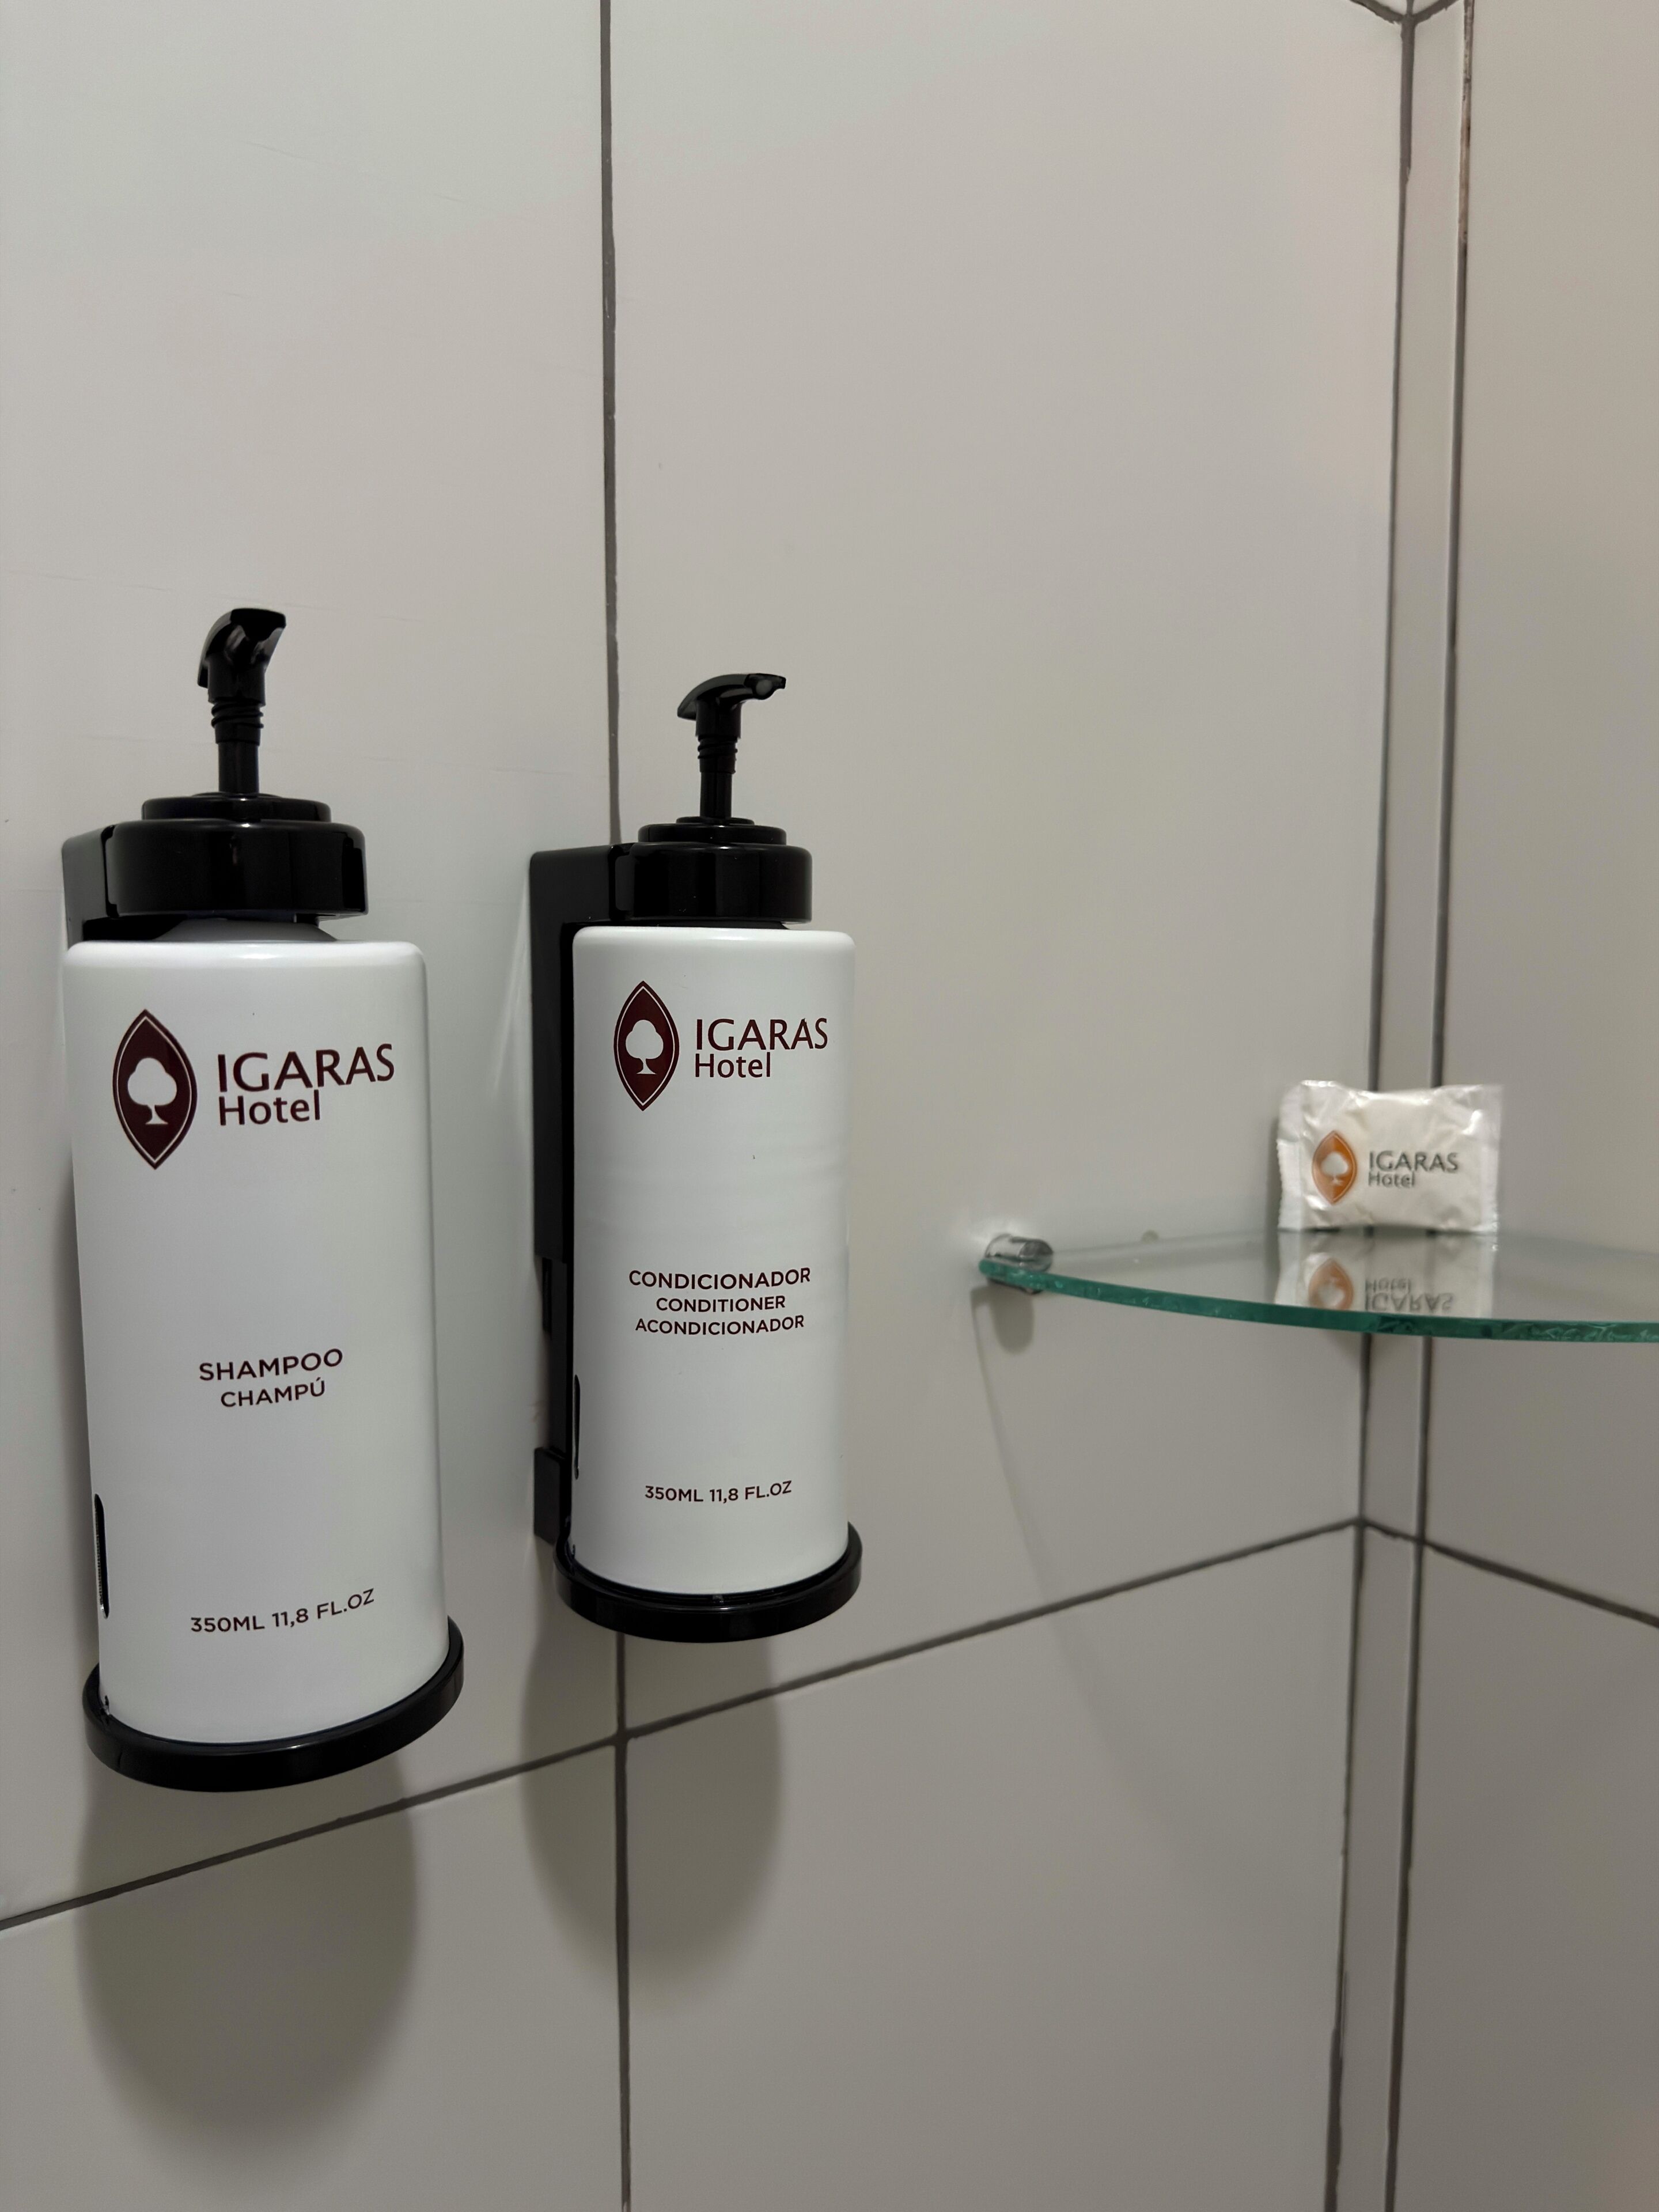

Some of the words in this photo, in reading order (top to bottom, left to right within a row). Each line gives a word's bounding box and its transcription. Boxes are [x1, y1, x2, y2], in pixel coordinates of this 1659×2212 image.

[696, 1017, 828, 1051] IGARAS
[217, 1043, 395, 1092] IGARAS
[695, 1052, 771, 1078] Hotel
[218, 1089, 321, 1126] Hotel
[1369, 1150, 1459, 1173] IGARAS
[1368, 1171, 1416, 1187] Hotel
[629, 1267, 810, 1290] CONDICIONADOR
[656, 1295, 786, 1312] CONDITIONER
[635, 1315, 805, 1335] ACONDICIONADOR
[199, 1348, 343, 1381] SHAMPOO
[220, 1377, 325, 1407] CHAMPÚ
[645, 1485, 704, 1502] 350ML
[709, 1488, 738, 1503] 11,8
[745, 1480, 792, 1500] FL.OZ
[191, 1615, 265, 1632] 350ML
[272, 1608, 309, 1627] 11,8
[316, 1588, 374, 1619] FL.OZ
